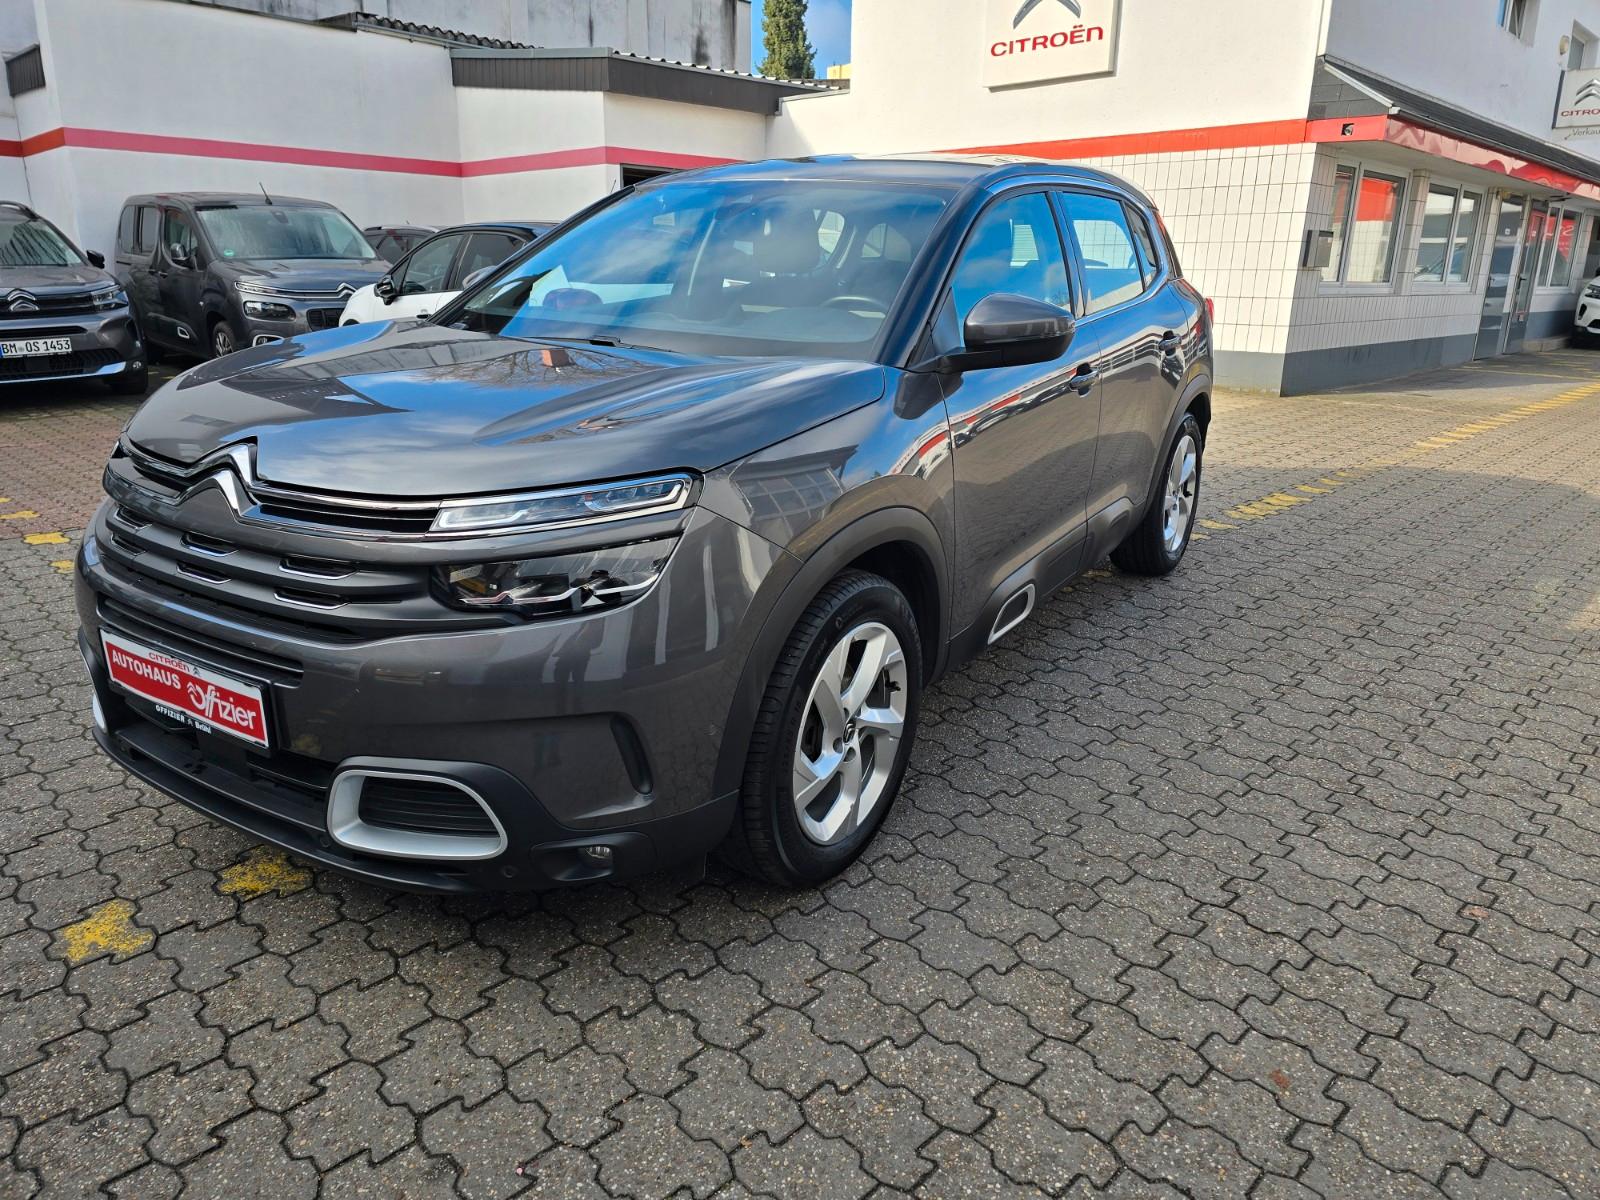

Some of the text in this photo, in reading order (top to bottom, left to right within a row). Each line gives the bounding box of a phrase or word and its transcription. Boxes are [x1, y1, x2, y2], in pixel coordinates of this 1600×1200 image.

[1, 339, 70, 354] BM OS 1453
[112, 650, 181, 690] AUTOHAUS
[155, 704, 185, 723] OFFIZIER
